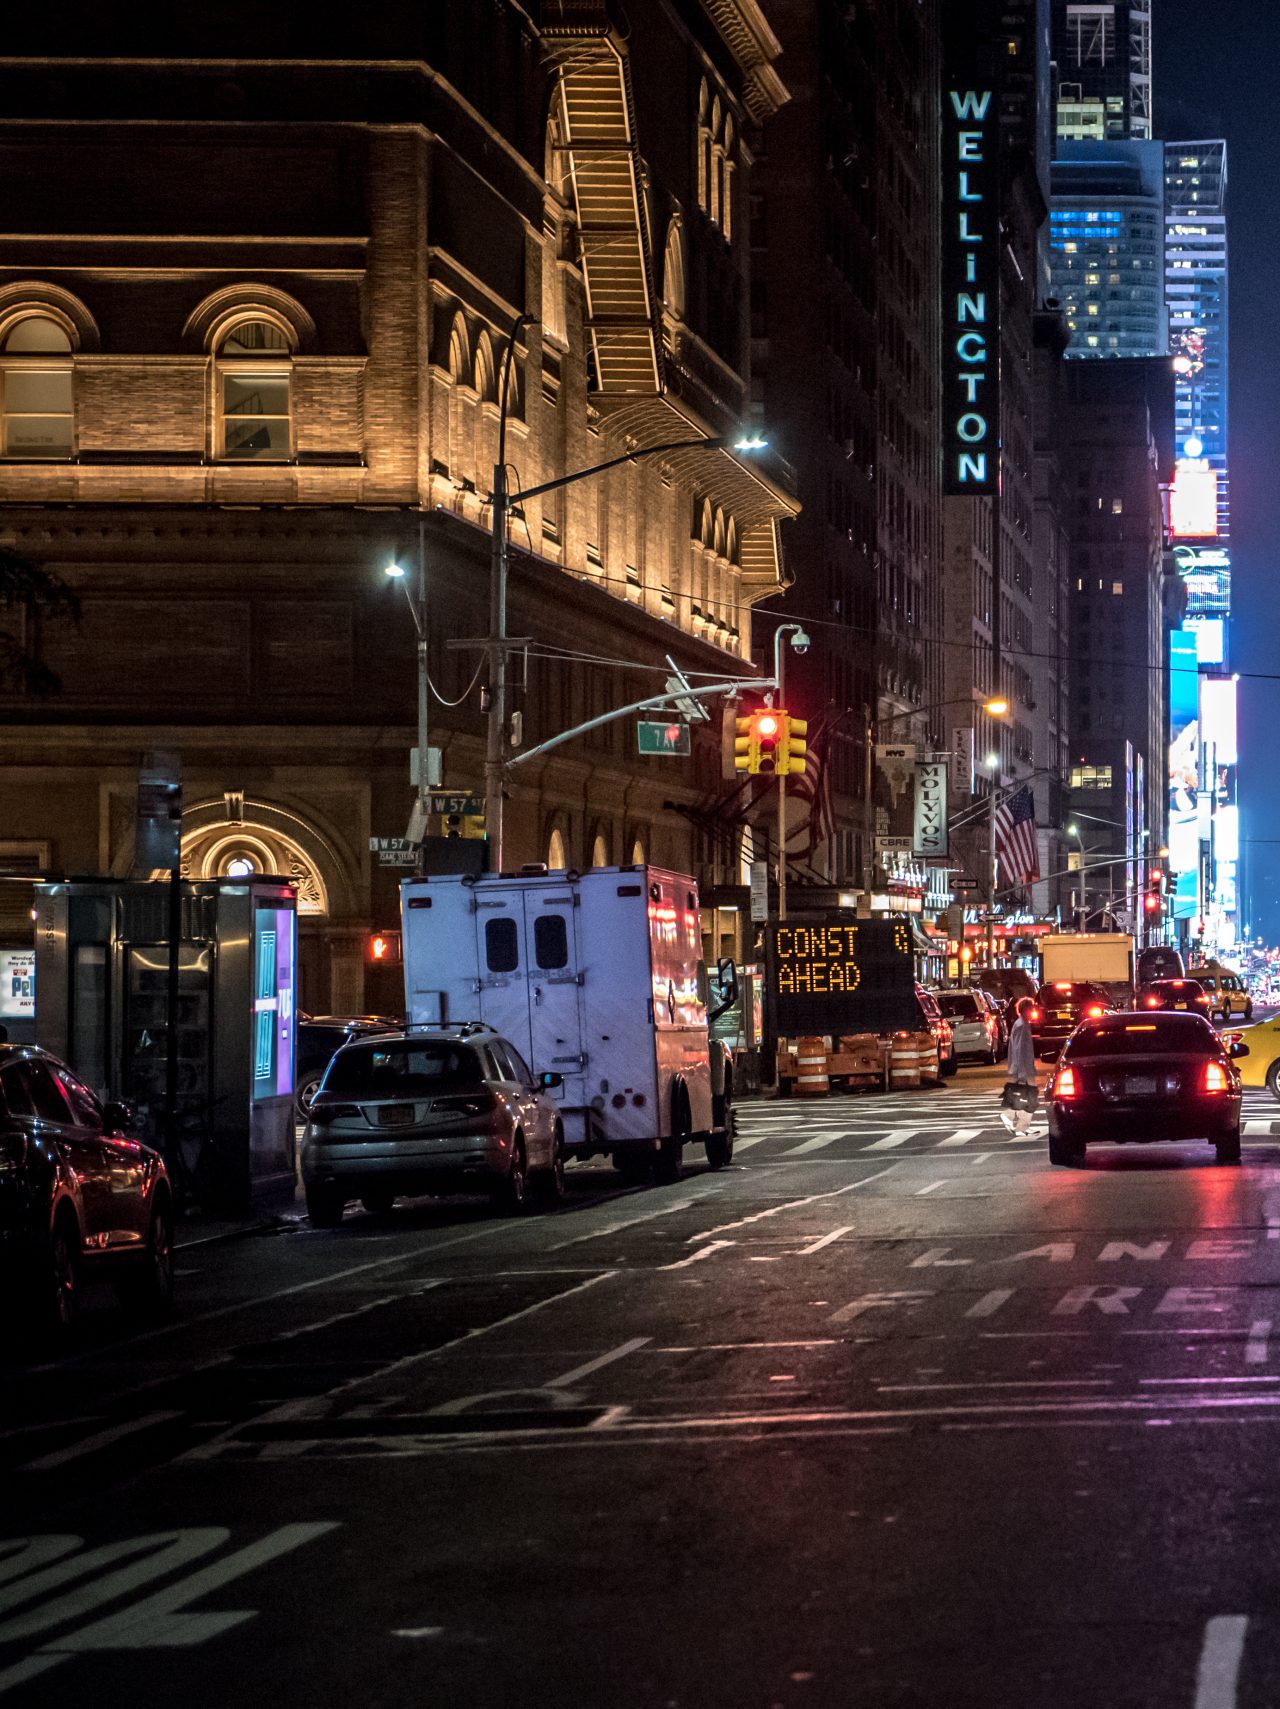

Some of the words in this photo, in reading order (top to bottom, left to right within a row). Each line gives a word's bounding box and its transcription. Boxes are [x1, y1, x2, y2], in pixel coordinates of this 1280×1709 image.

[949, 90, 993, 483] WELLINGTON
[654, 729, 660, 748] 7
[435, 798, 446, 812] W
[450, 798, 466, 812] 57
[920, 767, 940, 848] MOLYVOS
[380, 838, 389, 849] W
[391, 838, 404, 849] 57
[879, 838, 910, 847] CBRE
[777, 926, 859, 958] CONST
[778, 961, 861, 994] AHEAD
[907, 1238, 1258, 1270] LANE
[825, 1285, 1241, 1323] FIRE
